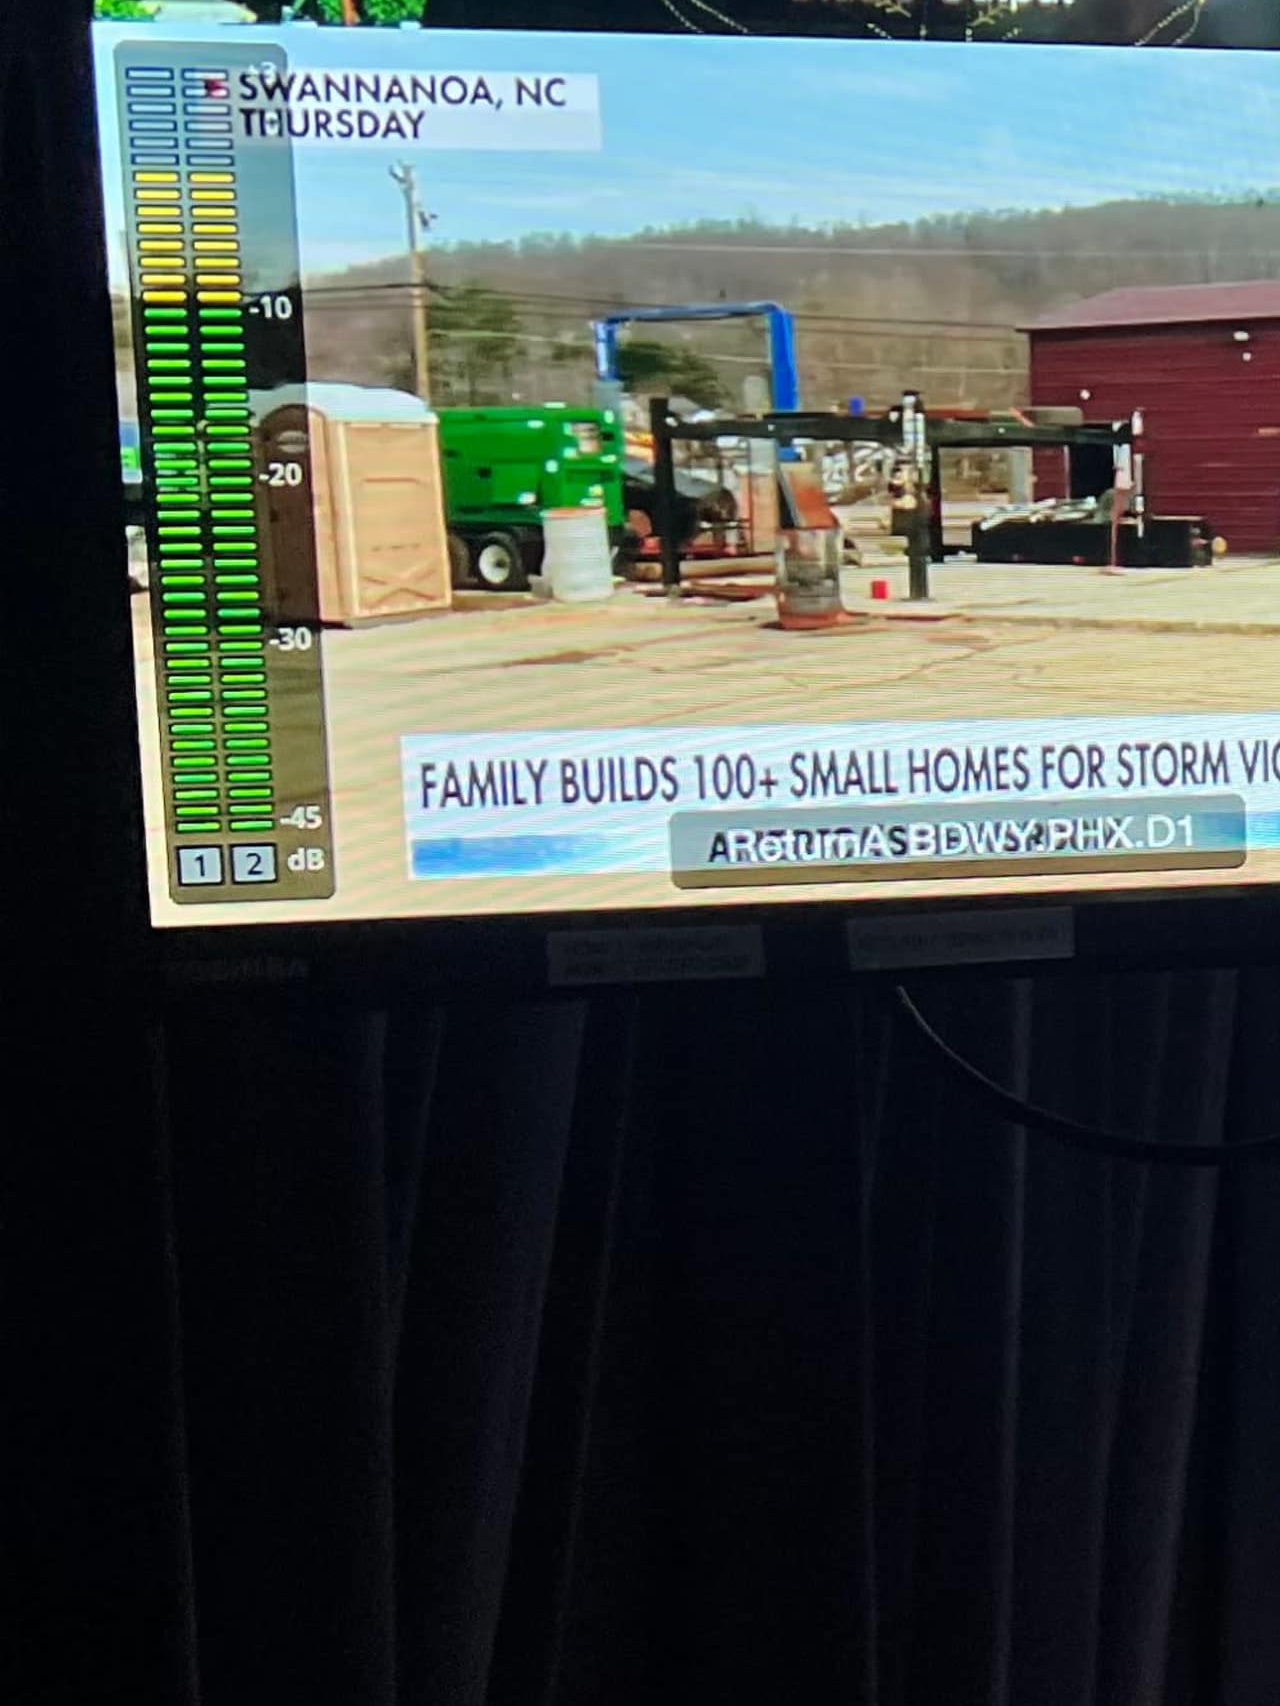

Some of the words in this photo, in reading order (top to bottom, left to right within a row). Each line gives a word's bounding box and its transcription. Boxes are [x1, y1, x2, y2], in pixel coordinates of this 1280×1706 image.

[239, 73, 503, 111] SWANNANOA,
[516, 77, 566, 106] NC
[240, 107, 425, 139] THURSDAY
[250, 295, 293, 321] -10
[260, 462, 302, 488] -20
[270, 627, 312, 653] -30
[420, 759, 547, 809] FAMILY
[561, 756, 679, 804] BUILDS
[693, 753, 776, 799] 100+
[790, 749, 898, 797] SMALL
[909, 746, 1031, 793] HOMES
[1043, 744, 1105, 790] FOR
[1117, 739, 1230, 788] STORM
[281, 806, 323, 832] -45
[247, 852, 264, 877] 2
[288, 848, 325, 873] dB
